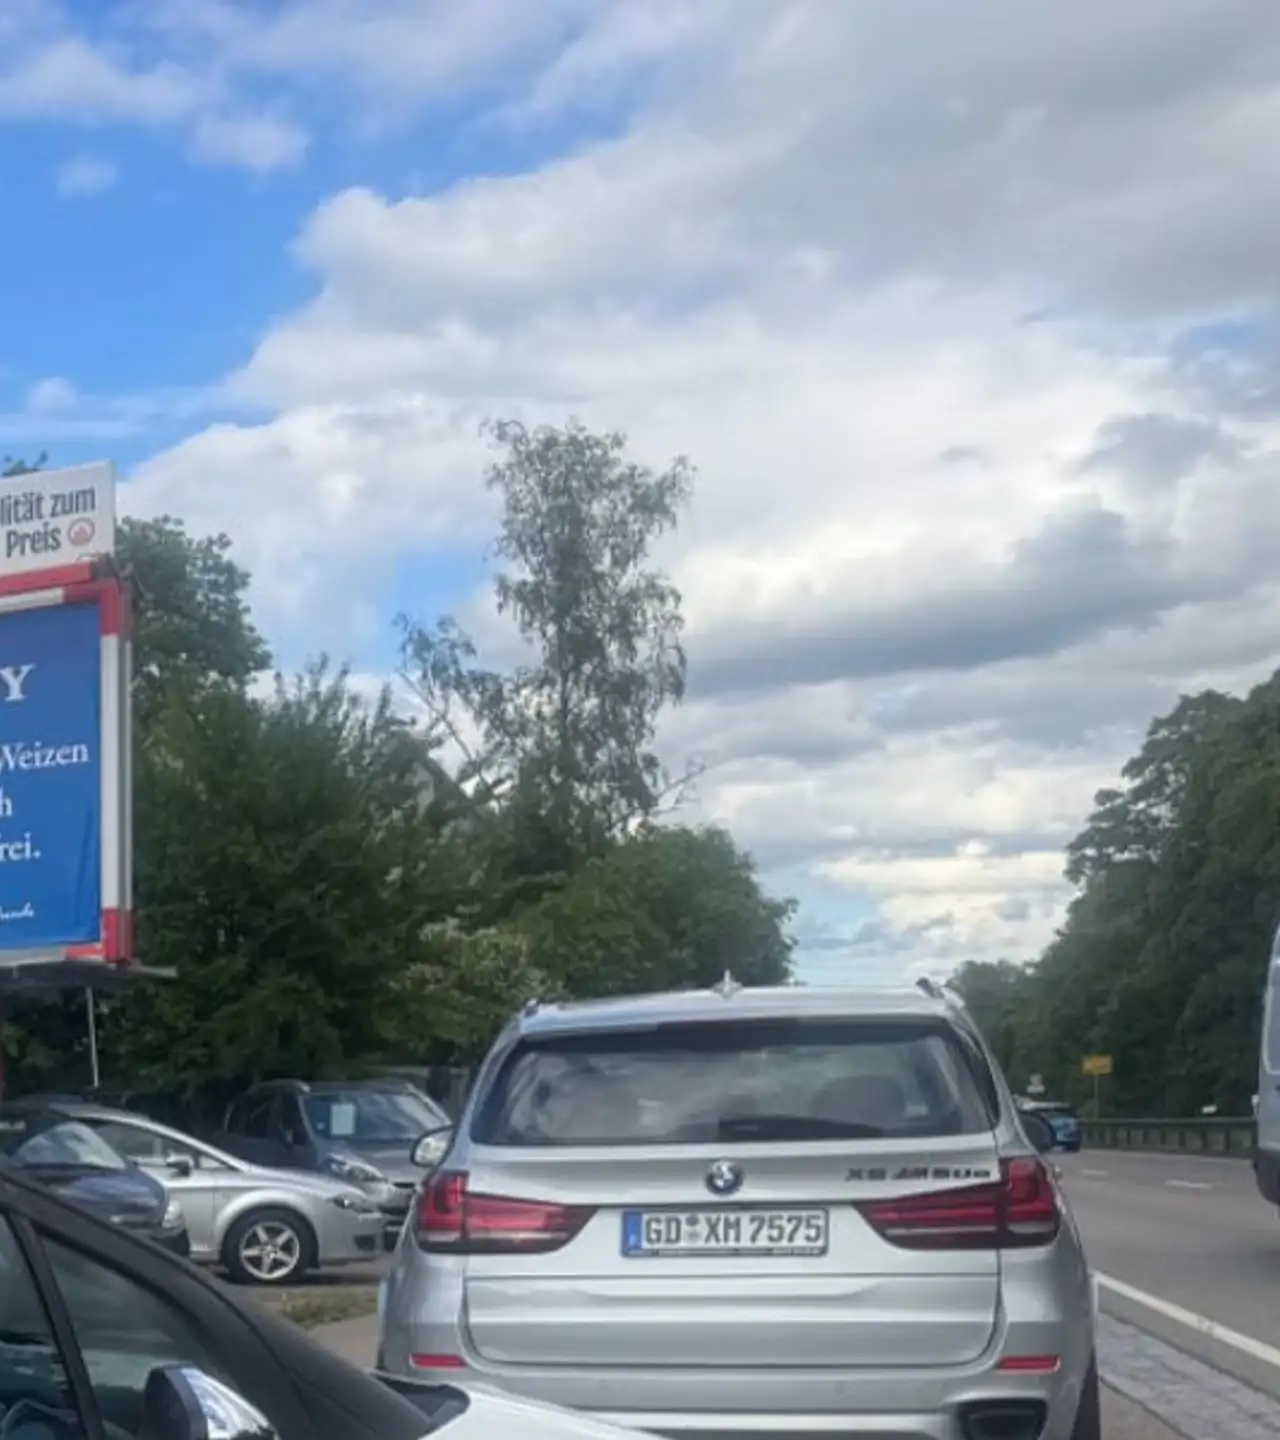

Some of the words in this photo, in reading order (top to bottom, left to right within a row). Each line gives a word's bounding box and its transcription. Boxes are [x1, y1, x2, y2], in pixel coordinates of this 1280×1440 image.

[51, 487, 96, 518] zum
[6, 522, 62, 559] Preis
[645, 1214, 682, 1245] GD
[704, 1214, 741, 1244] XM
[748, 1214, 823, 1244] 7575
